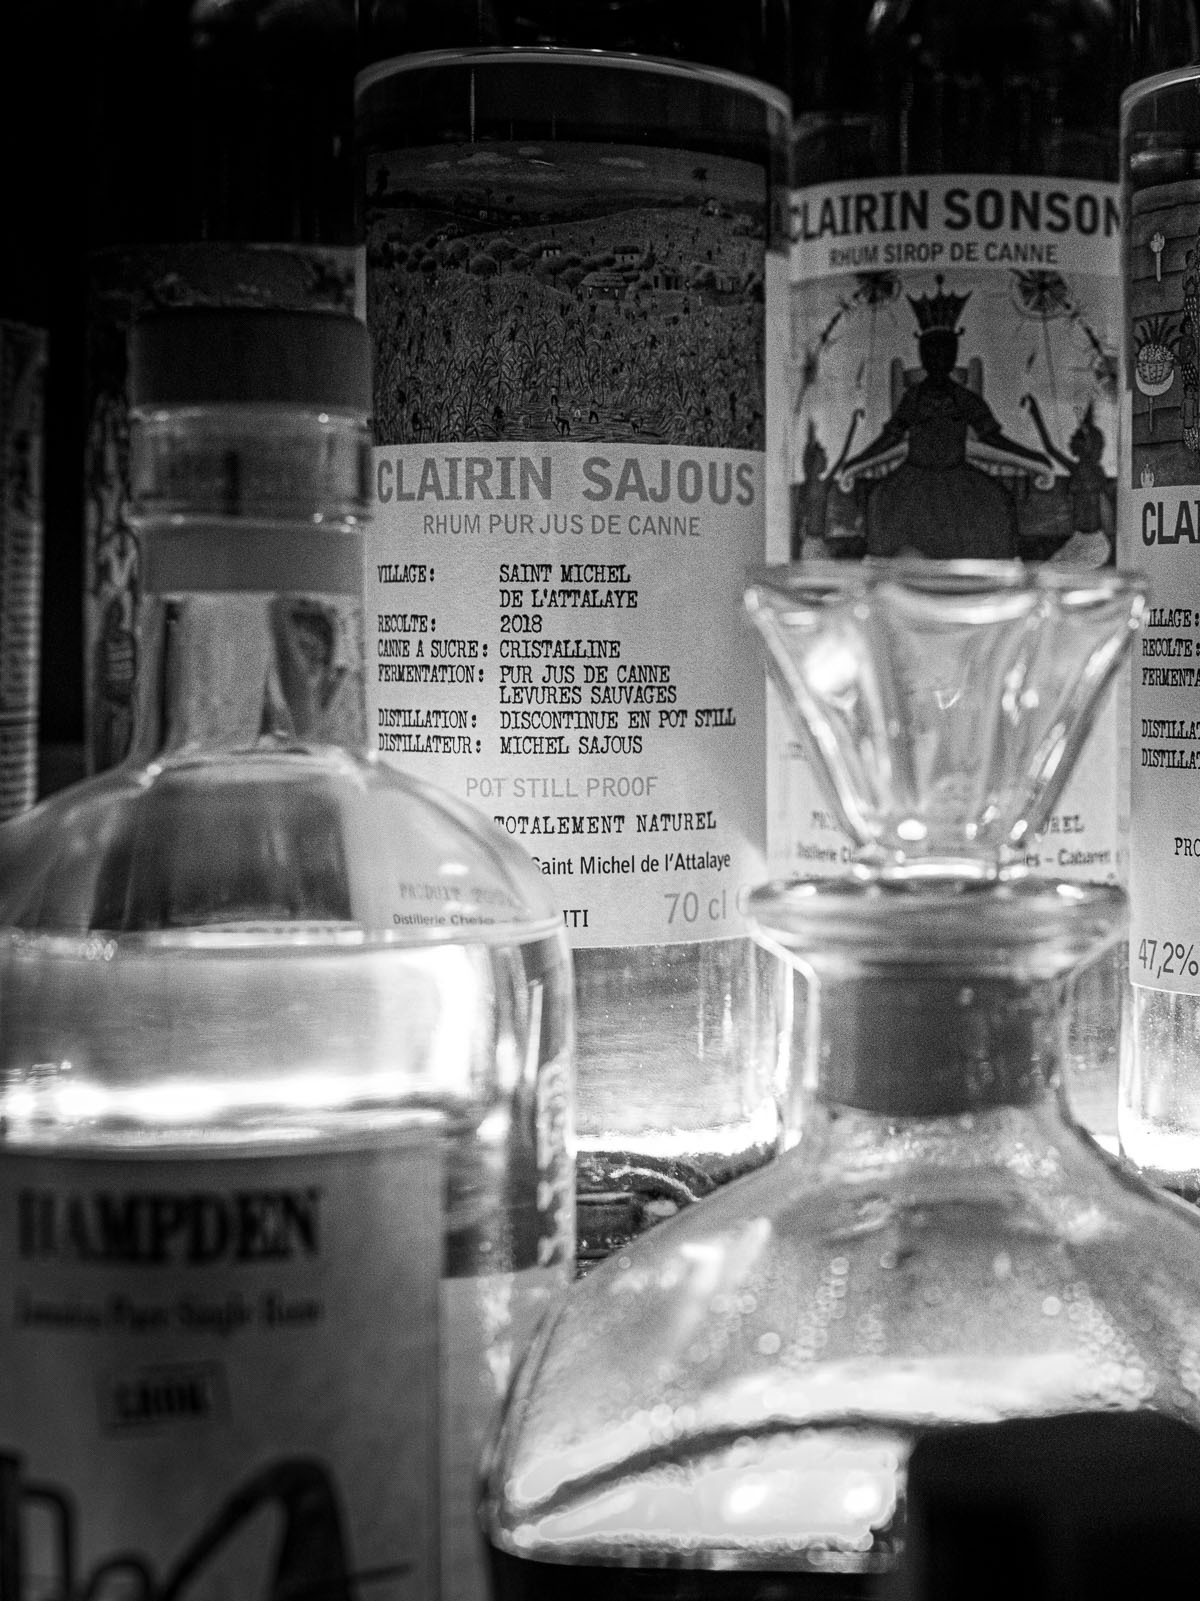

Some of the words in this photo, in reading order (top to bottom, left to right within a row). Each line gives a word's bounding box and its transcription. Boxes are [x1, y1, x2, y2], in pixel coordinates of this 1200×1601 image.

[944, 188, 1120, 237] SONSON
[884, 242, 943, 264] SIROP
[951, 242, 980, 261] DE
[984, 242, 1058, 264] CANNE
[376, 456, 552, 504] CLAIRIN
[582, 456, 755, 506] SAJOUS
[423, 515, 481, 535] RHUM
[489, 514, 534, 535] PUR
[539, 515, 584, 535] JUS
[591, 515, 621, 535] DE
[628, 516, 700, 536] CANNE
[500, 564, 552, 583] SAINT
[560, 565, 631, 583] MICHEL
[500, 590, 524, 608] DE
[532, 588, 638, 609] L'ATTALAYE
[500, 615, 543, 633] 2018
[1144, 609, 1200, 628] ILLAGE:
[378, 640, 410, 659] CANNE
[416, 640, 425, 658] A
[500, 640, 621, 659] CRISTALLINE
[500, 665, 532, 684] PUR
[542, 665, 576, 684] JUS
[584, 665, 608, 683] DE
[616, 665, 670, 683] CANNE
[499, 686, 583, 704] LEVURES
[591, 685, 677, 704] SAUVAGES
[500, 711, 618, 730] DISCONTINUE
[628, 710, 651, 728] EN
[658, 710, 689, 728] POT
[695, 708, 736, 727] STILL
[500, 736, 569, 755] MICHEL
[578, 735, 643, 754] SAJOUS
[466, 777, 507, 798] POT
[513, 777, 578, 798] STILL
[586, 776, 658, 798] PROOF
[636, 811, 717, 833] NATUREL
[580, 855, 635, 874] Michel
[640, 855, 659, 872] de
[664, 892, 698, 924] 70
[708, 888, 727, 920] cl
[563, 909, 589, 928] ITI
[1138, 939, 1199, 979] 47,2%
